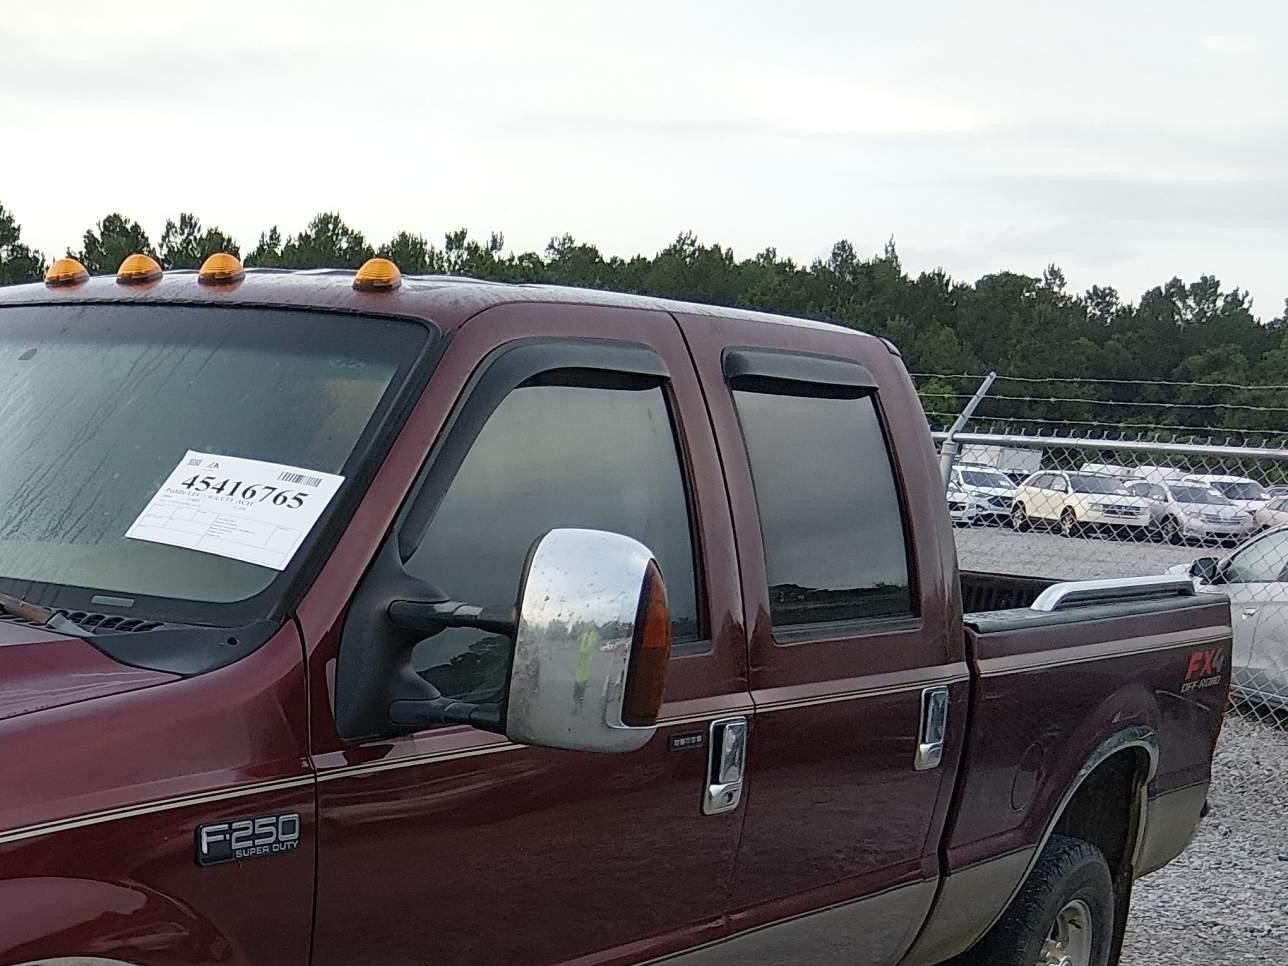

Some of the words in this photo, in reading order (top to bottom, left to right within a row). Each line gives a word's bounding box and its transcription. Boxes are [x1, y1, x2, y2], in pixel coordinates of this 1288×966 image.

[181, 474, 309, 509] 45416765
[1184, 647, 1225, 681] FX4
[235, 846, 270, 858] SUPER
[272, 840, 299, 853] DUTY
